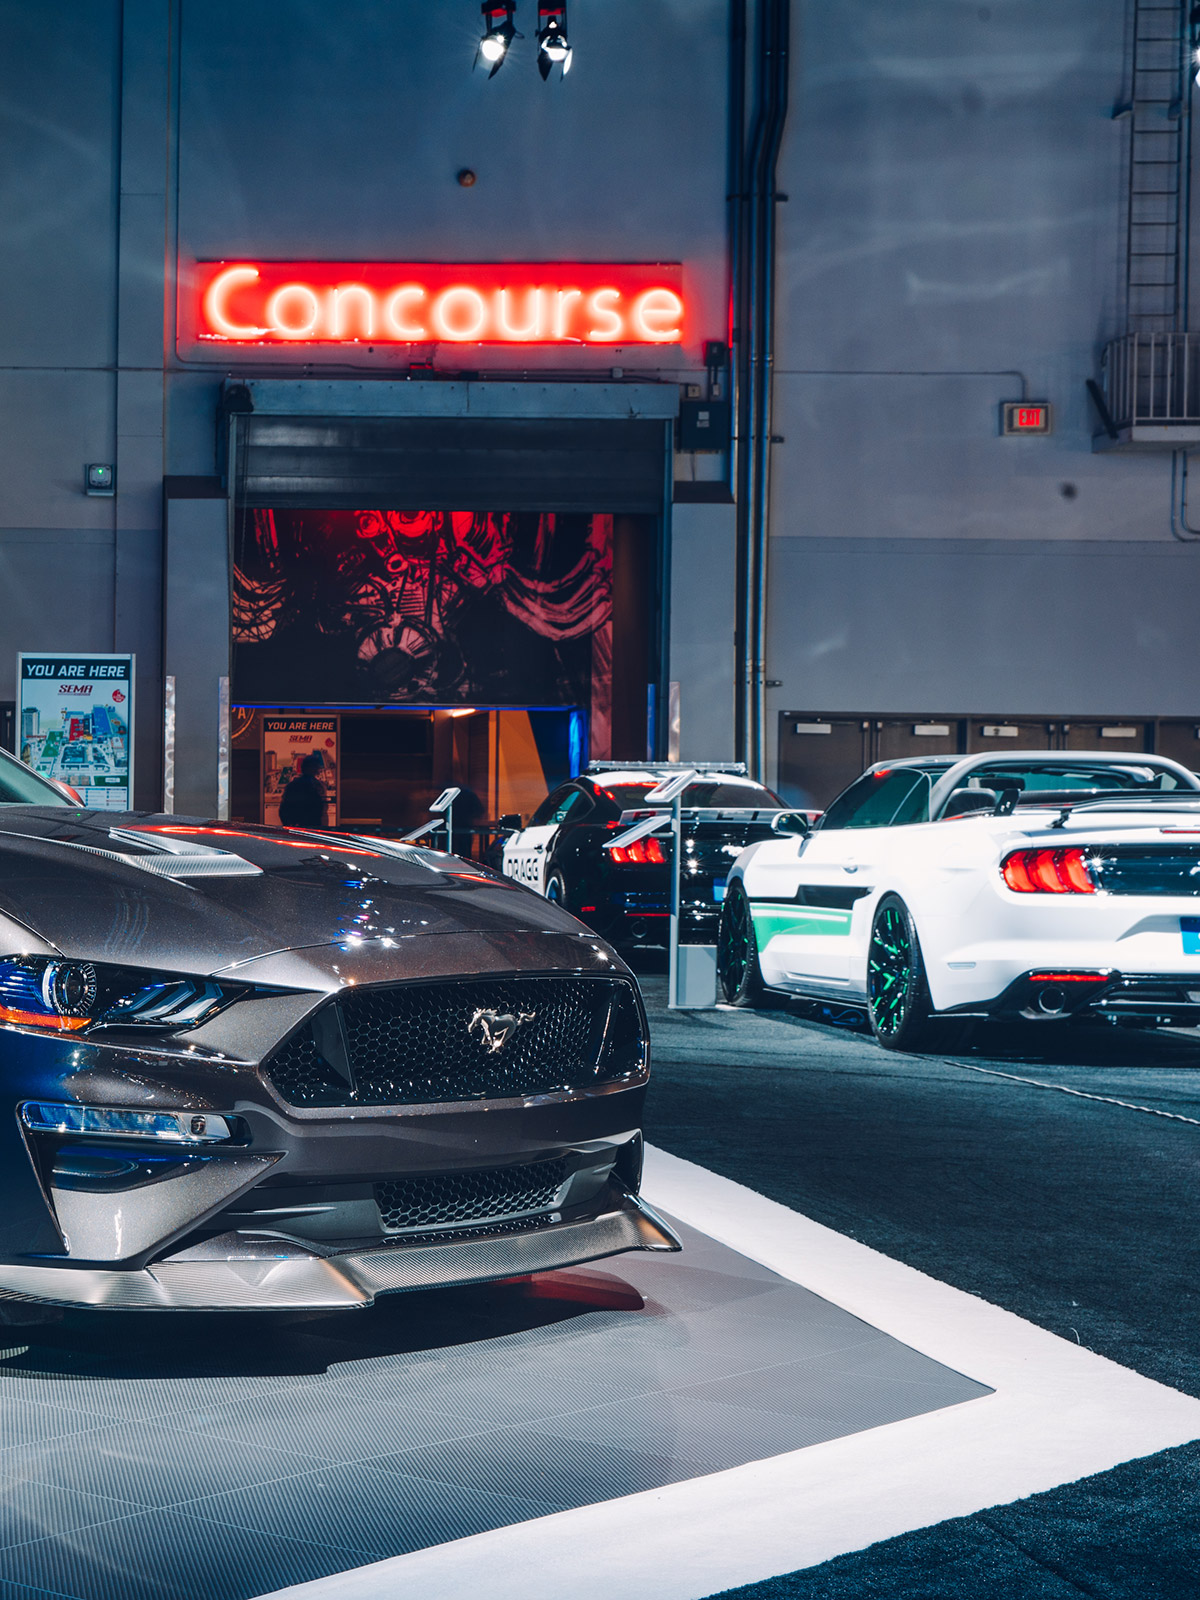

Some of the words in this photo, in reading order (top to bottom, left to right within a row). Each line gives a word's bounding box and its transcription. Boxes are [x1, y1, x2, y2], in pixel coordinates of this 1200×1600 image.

[206, 265, 683, 342] Concourse
[1018, 408, 1041, 427] EXIT
[27, 664, 55, 677] YOU
[58, 664, 86, 677] ARE
[88, 665, 126, 677] HERE
[58, 684, 94, 694] SEMA
[267, 721, 287, 731] YOU
[288, 721, 307, 731] ARE
[309, 721, 335, 731] HERE
